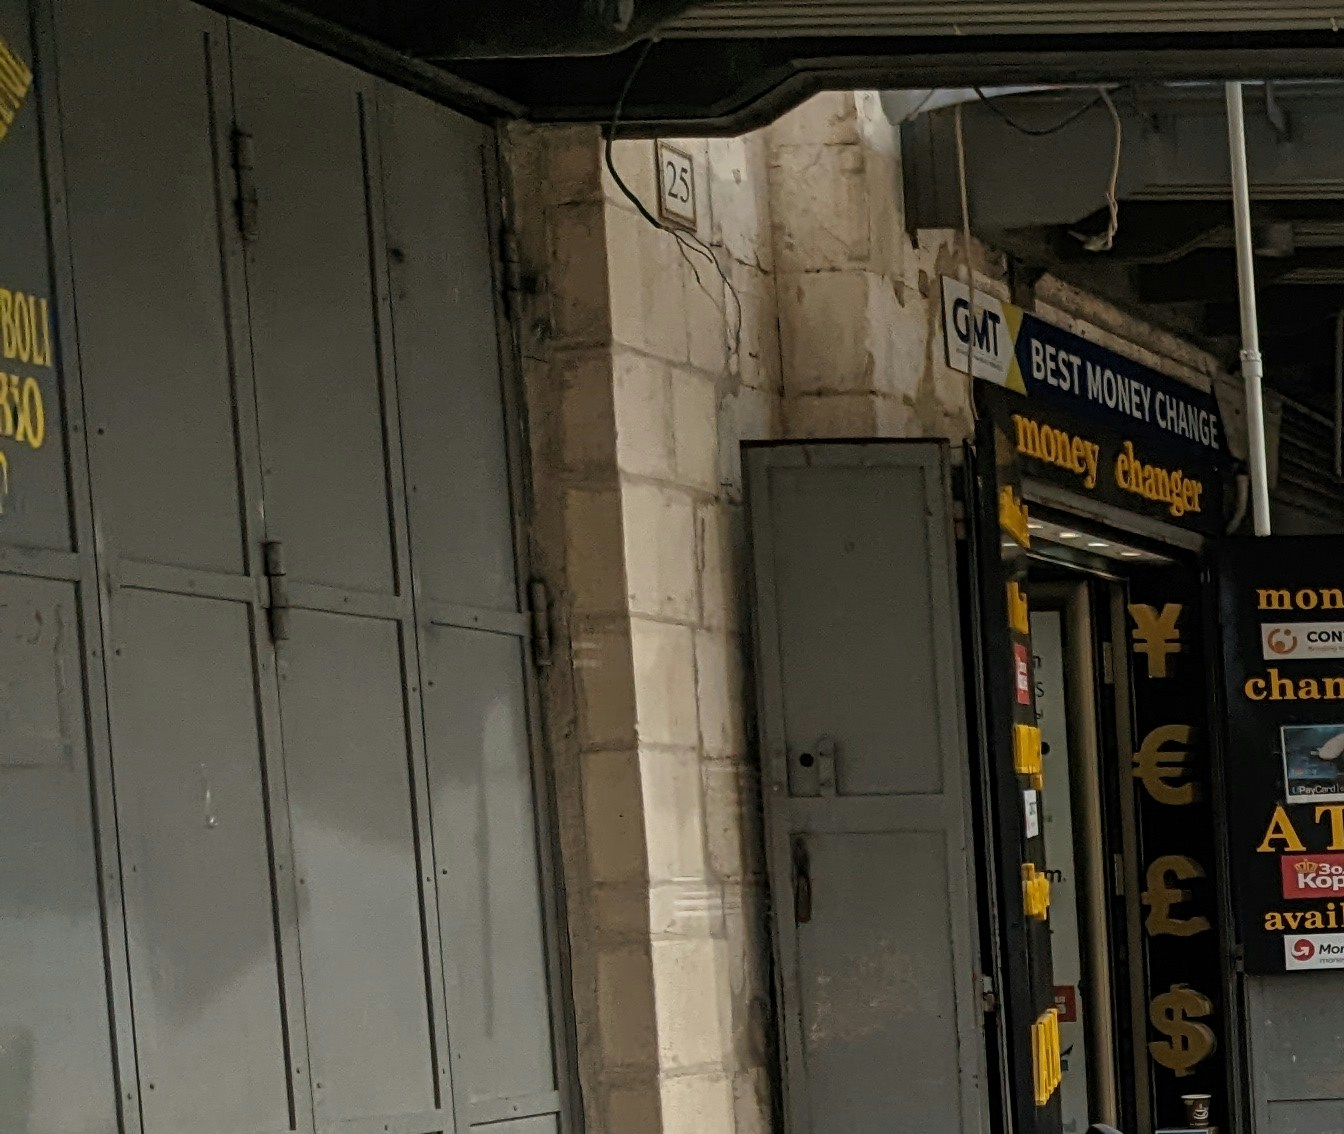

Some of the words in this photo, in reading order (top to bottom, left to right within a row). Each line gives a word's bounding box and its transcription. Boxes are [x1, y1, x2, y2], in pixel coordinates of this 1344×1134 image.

[666, 160, 690, 203] 25
[952, 297, 1001, 357] GMT
[1029, 337, 1082, 396] BEST
[1086, 361, 1152, 423] MONEY
[1155, 390, 1220, 450] CHANGE
[1011, 413, 1100, 489] money
[1115, 440, 1203, 517] changer
